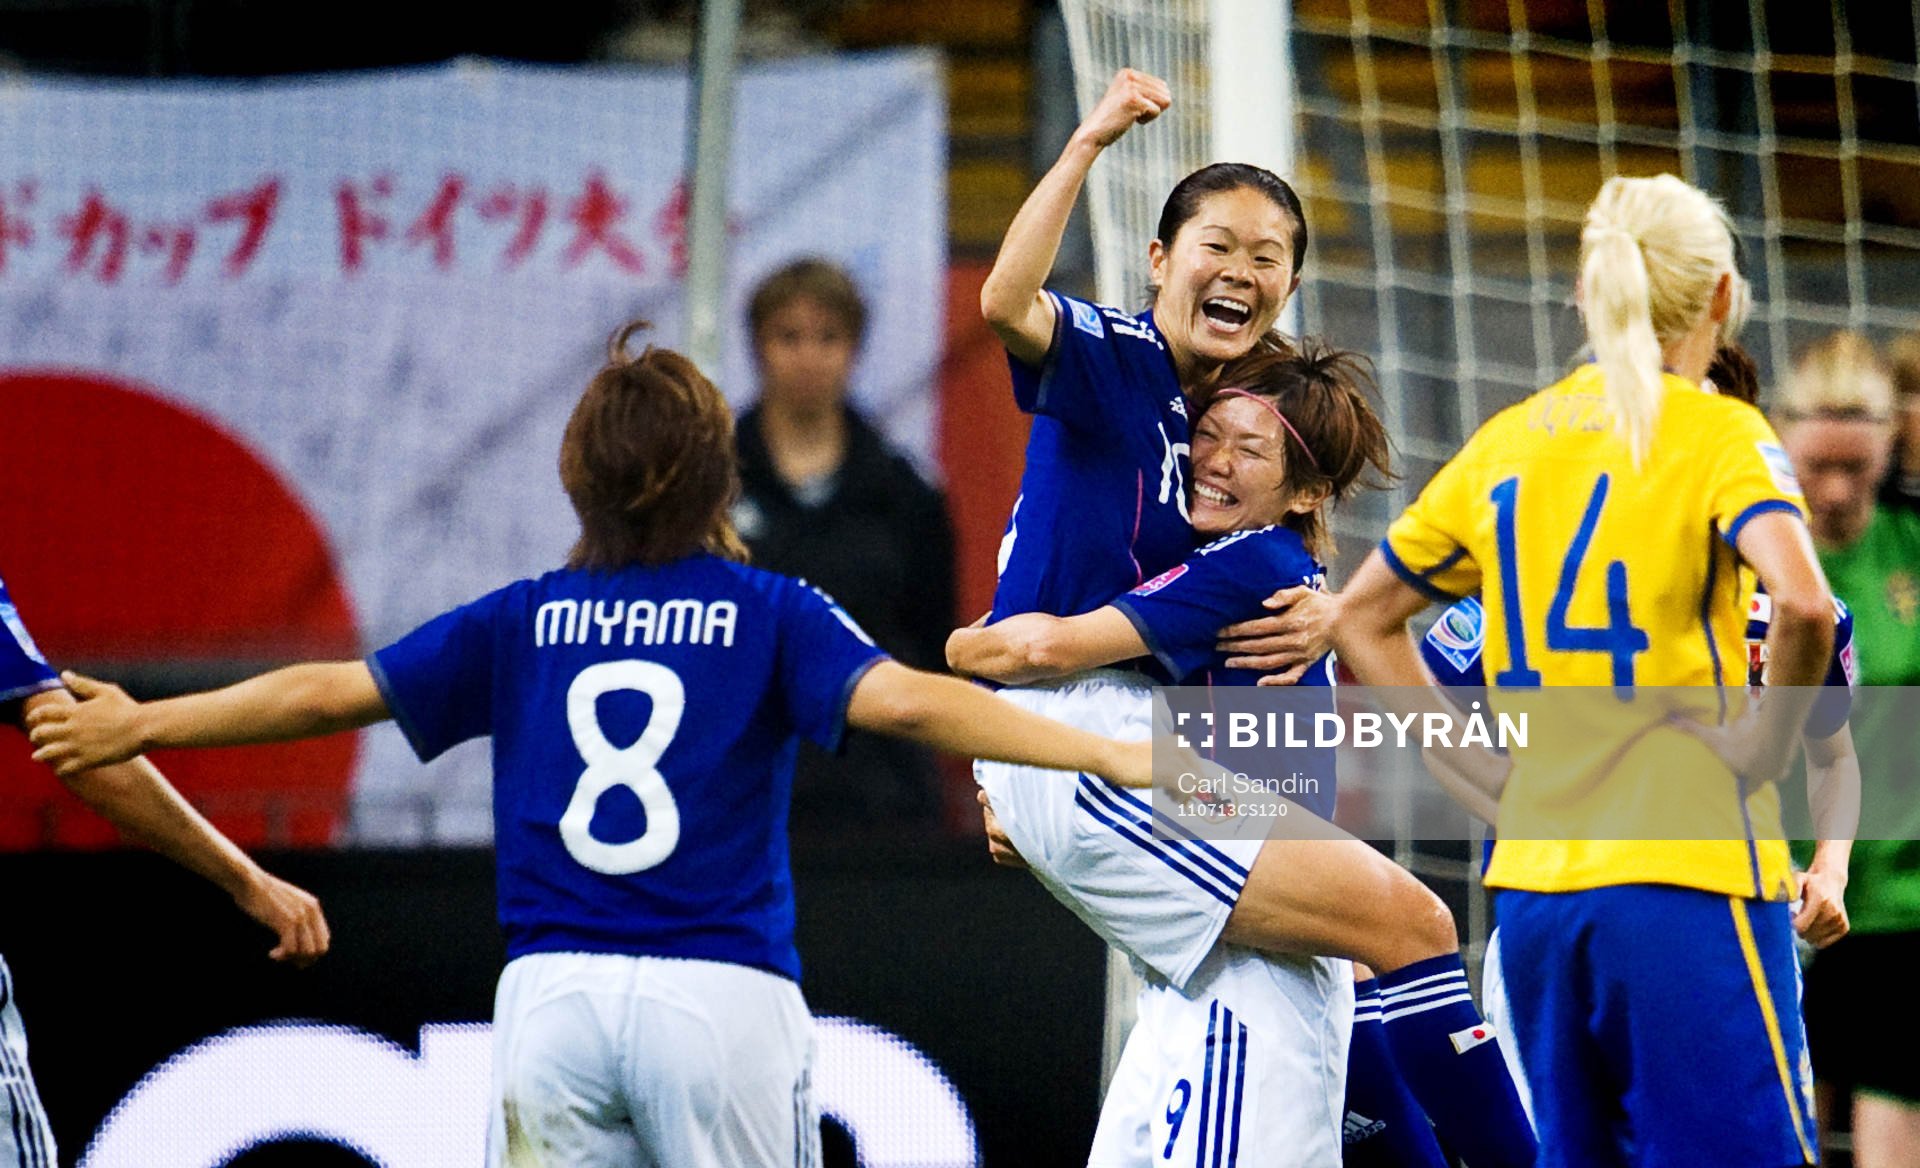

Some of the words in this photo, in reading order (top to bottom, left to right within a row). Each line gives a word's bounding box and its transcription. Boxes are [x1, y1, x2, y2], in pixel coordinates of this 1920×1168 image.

[535, 599, 738, 647] MIYAMA
[1490, 472, 1649, 701] 14
[559, 659, 686, 875] 8
[1163, 1078, 1191, 1160] 9
